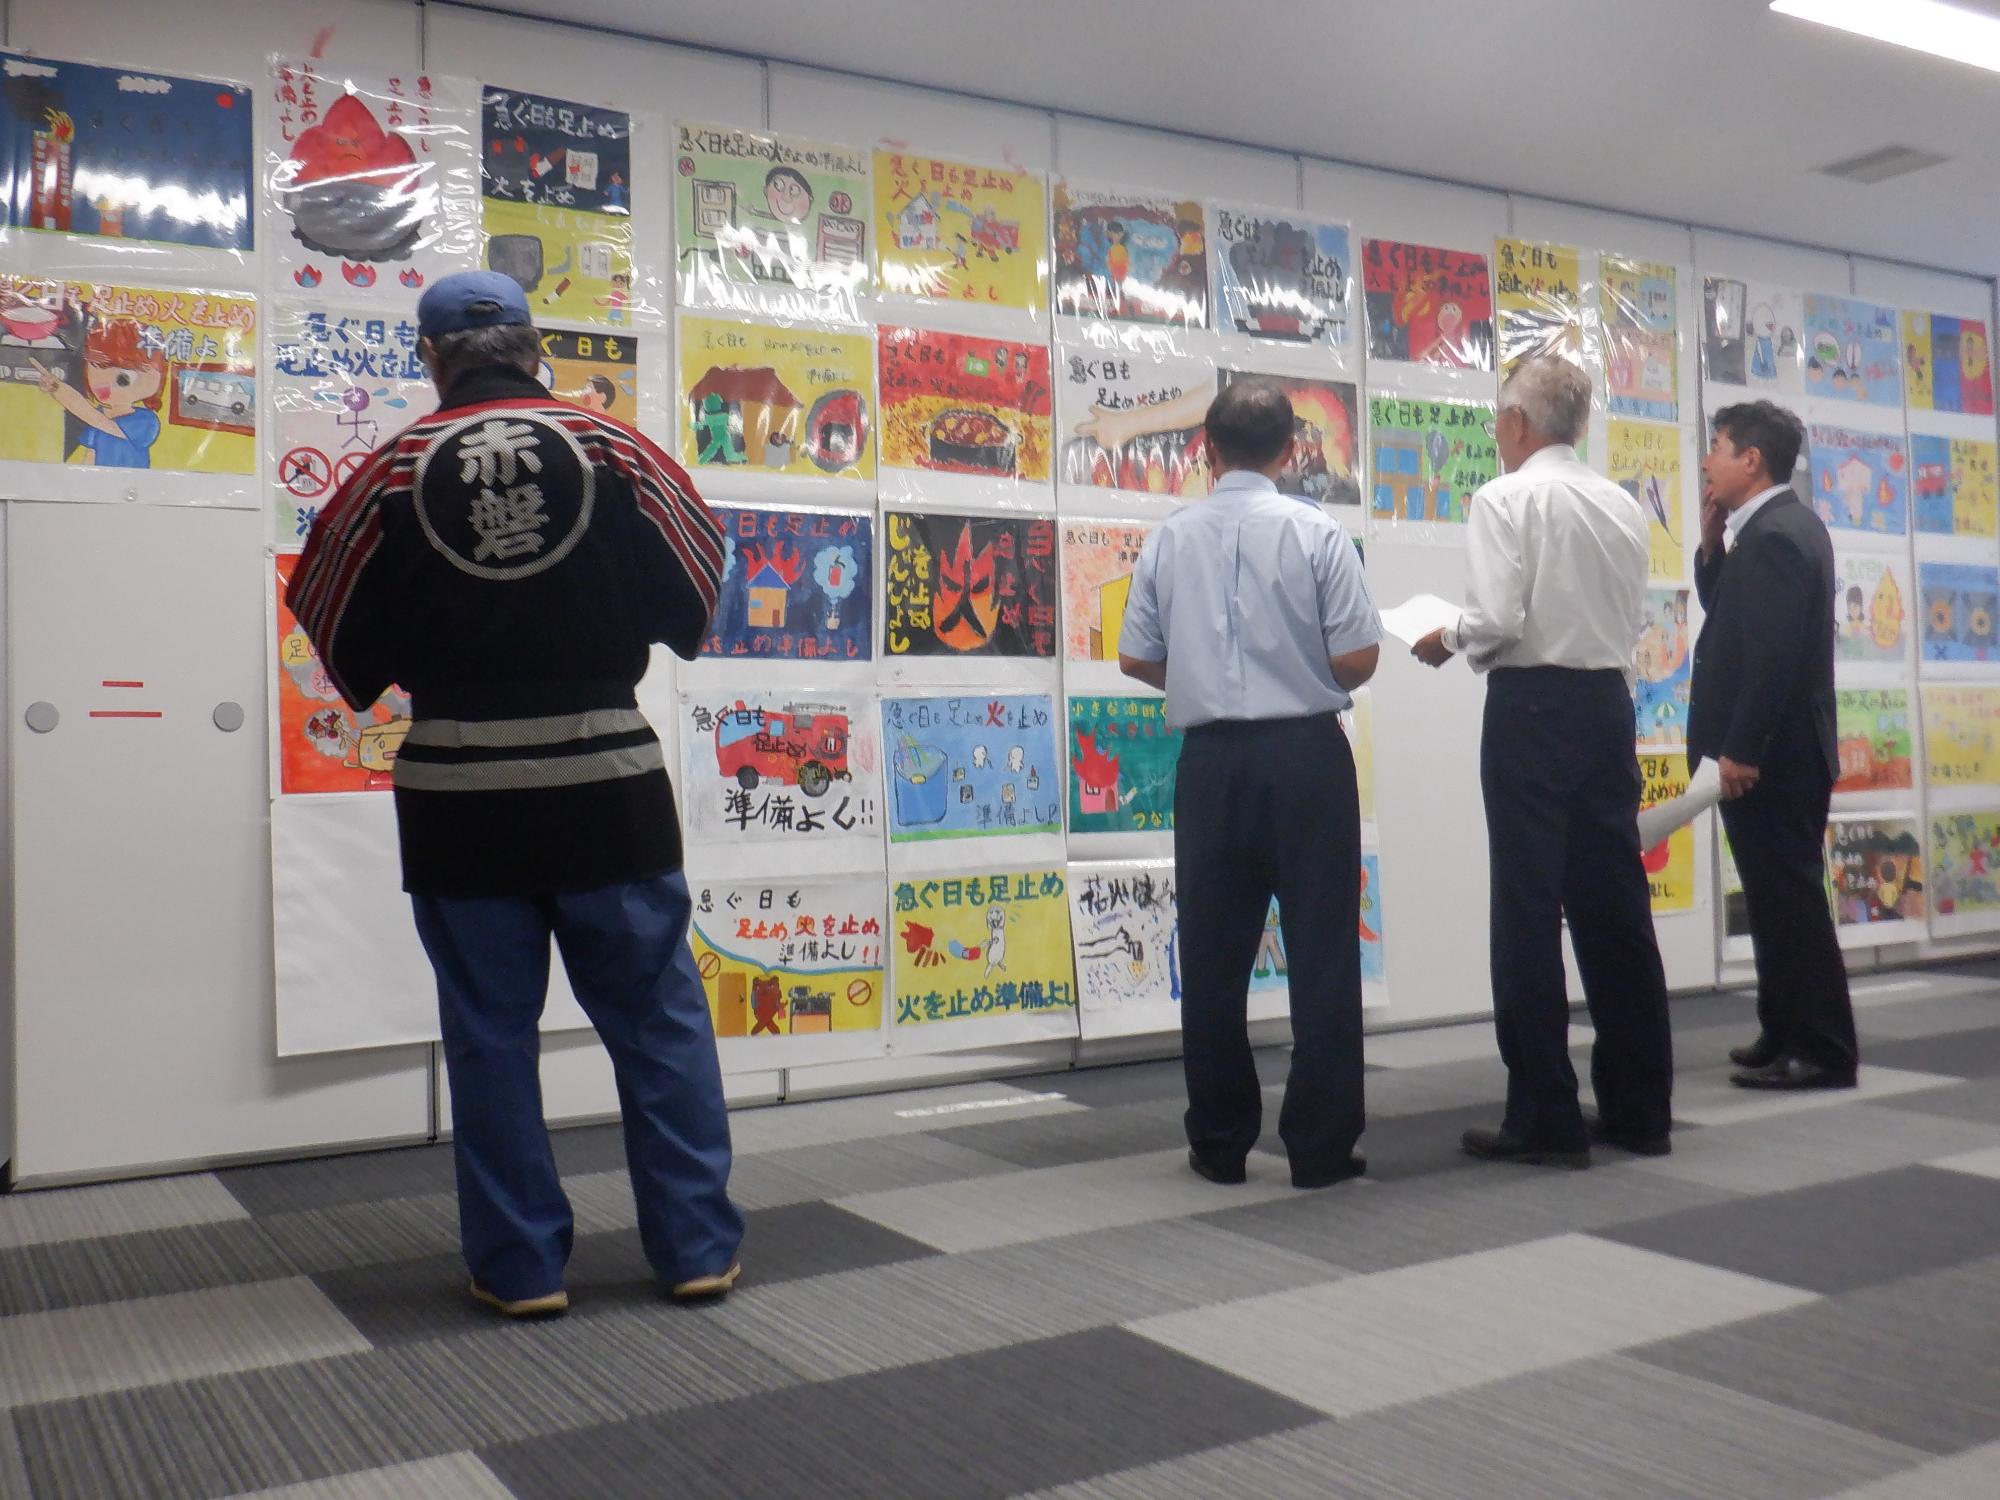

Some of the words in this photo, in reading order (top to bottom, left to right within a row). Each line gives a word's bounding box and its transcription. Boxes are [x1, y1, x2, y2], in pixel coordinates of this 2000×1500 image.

[457, 420, 551, 562] 赤磐
[691, 705, 765, 732] 急ぐ日も
[895, 872, 1064, 912] 急ぐ日も足止め
[897, 980, 1077, 1024] 火を止め準備よし
